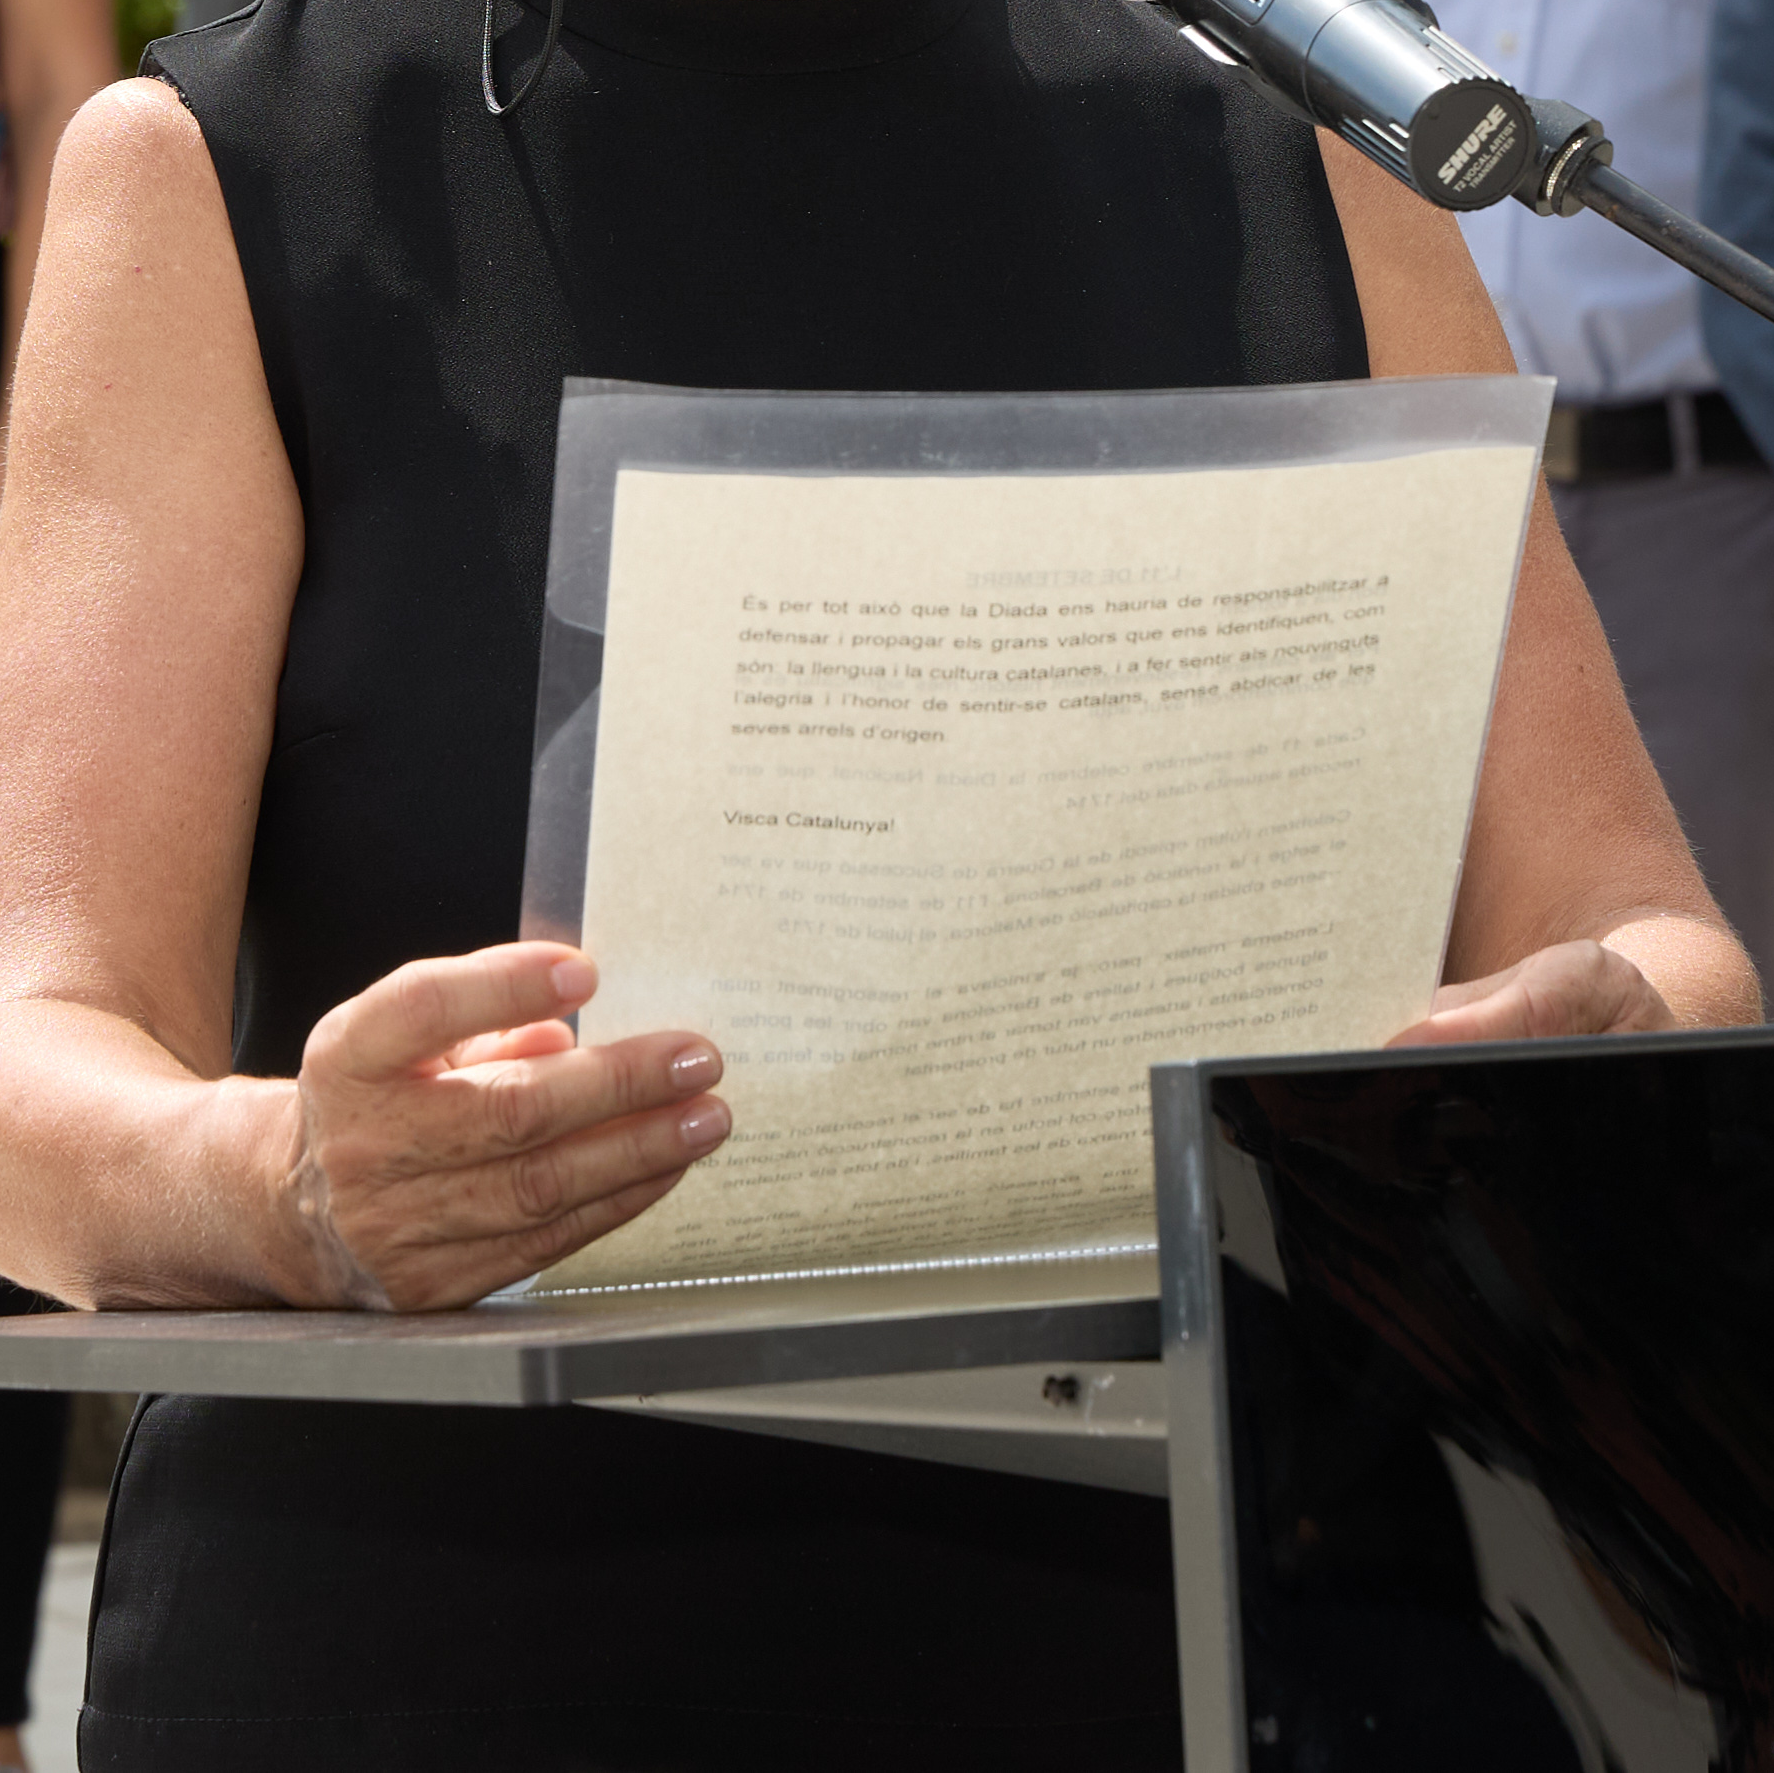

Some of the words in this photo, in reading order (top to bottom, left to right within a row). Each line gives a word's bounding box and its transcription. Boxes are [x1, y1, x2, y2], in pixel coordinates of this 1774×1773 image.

[1438, 104, 1507, 185] SHURE
[1462, 153, 1492, 182] VOCAL
[1489, 119, 1517, 153] ARTIST
[1468, 136, 1516, 188] TRANSMITTER
[741, 592, 768, 611] És
[779, 600, 812, 615] per
[822, 599, 849, 614] tot
[858, 599, 901, 615] això
[910, 604, 950, 619] que
[959, 601, 978, 617] la
[987, 601, 1049, 618] Diada
[1057, 602, 1095, 615] ens
[1104, 595, 1168, 613] hauria
[1177, 593, 1203, 609] de
[1213, 577, 1368, 606] responsabilitzar
[1376, 575, 1390, 587] a
[738, 625, 829, 645] defensar
[851, 634, 945, 651] propagar
[952, 633, 982, 650] els
[990, 636, 1049, 653] grans
[1057, 630, 1117, 647] valors
[1125, 629, 1163, 646] que
[1171, 625, 1208, 639] ens
[1216, 612, 1335, 636] identifiquen,
[1343, 605, 1385, 620] com
[786, 658, 805, 674] la
[811, 659, 887, 680] llengua
[905, 662, 923, 678] la
[929, 664, 999, 681] cultura
[1005, 663, 1107, 681] catalanes,
[1127, 661, 1139, 673] a
[1145, 656, 1172, 672] fer
[1178, 649, 1233, 668] sentir
[1238, 645, 1267, 662] als
[1273, 635, 1380, 658] nouvinguts
[733, 687, 813, 709] l'alegria
[841, 690, 911, 710] l'honor
[922, 695, 949, 711] de
[959, 697, 1048, 712] sentir-se
[1058, 690, 1148, 709] catalans,
[1160, 684, 1219, 701] sense
[1229, 673, 1303, 693] abdicar
[1311, 666, 1337, 682] de
[1347, 661, 1375, 677] les
[730, 723, 791, 735] seves
[797, 721, 855, 738] arrels
[722, 808, 778, 826] Visca
[784, 811, 895, 835] Catalunya!
